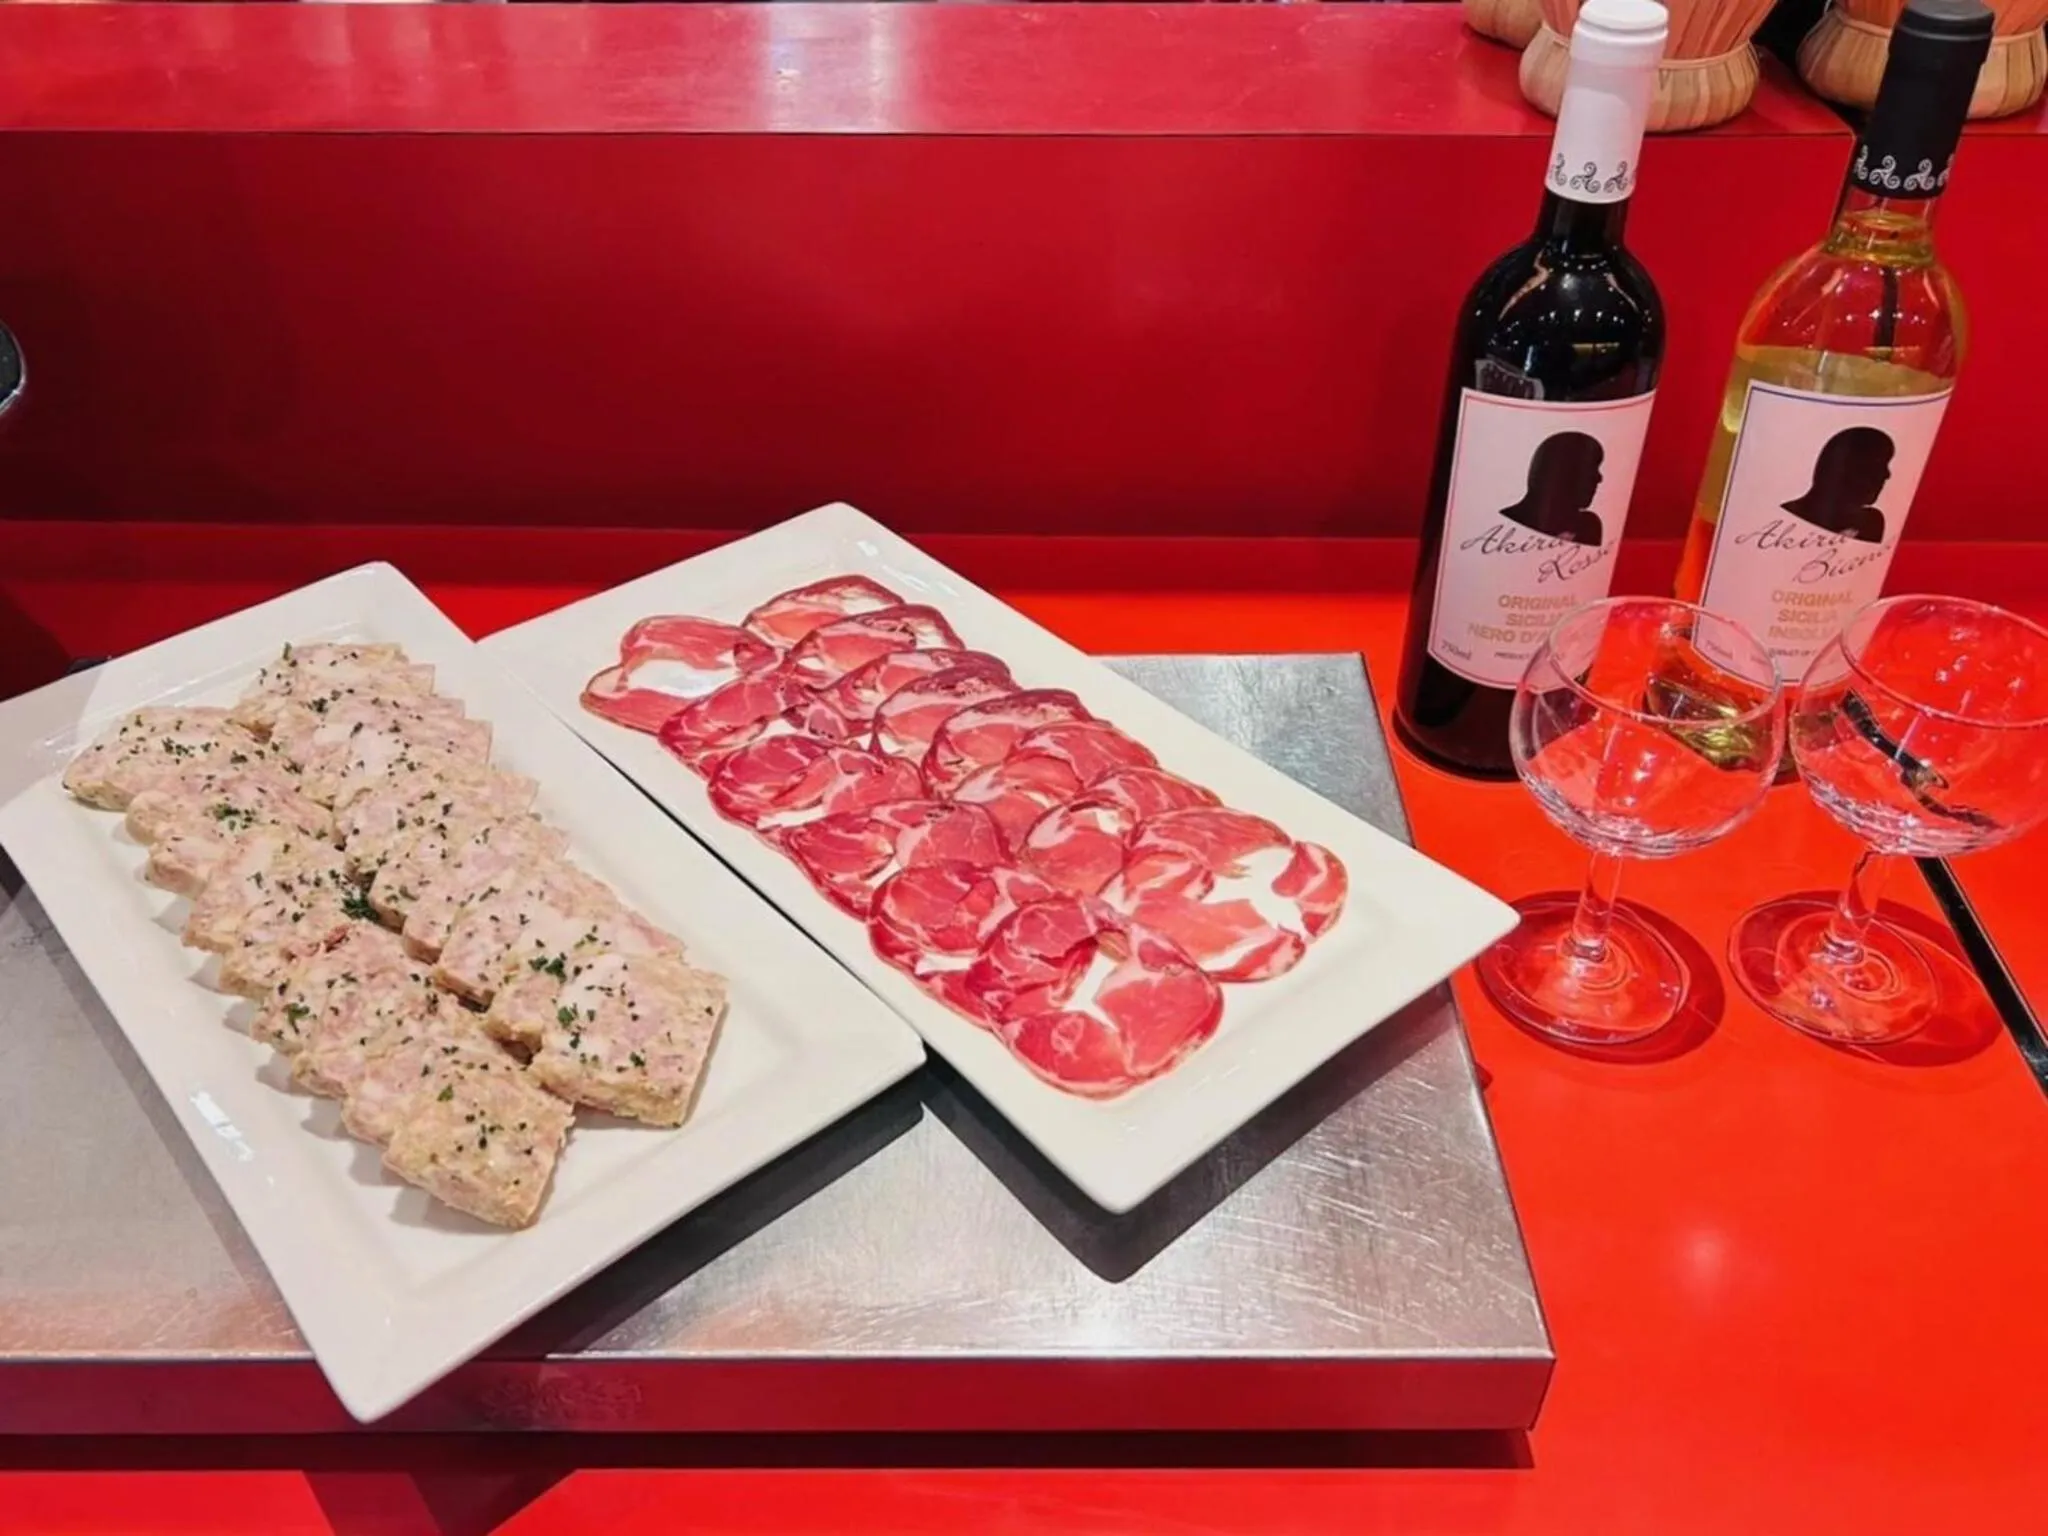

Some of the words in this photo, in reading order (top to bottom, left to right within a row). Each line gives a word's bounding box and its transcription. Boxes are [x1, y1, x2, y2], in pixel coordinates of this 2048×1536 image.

[1498, 594, 1577, 610] ORIGINAL
[1771, 590, 1854, 608] ORIGINAL
[1468, 623, 1517, 644] NERO
